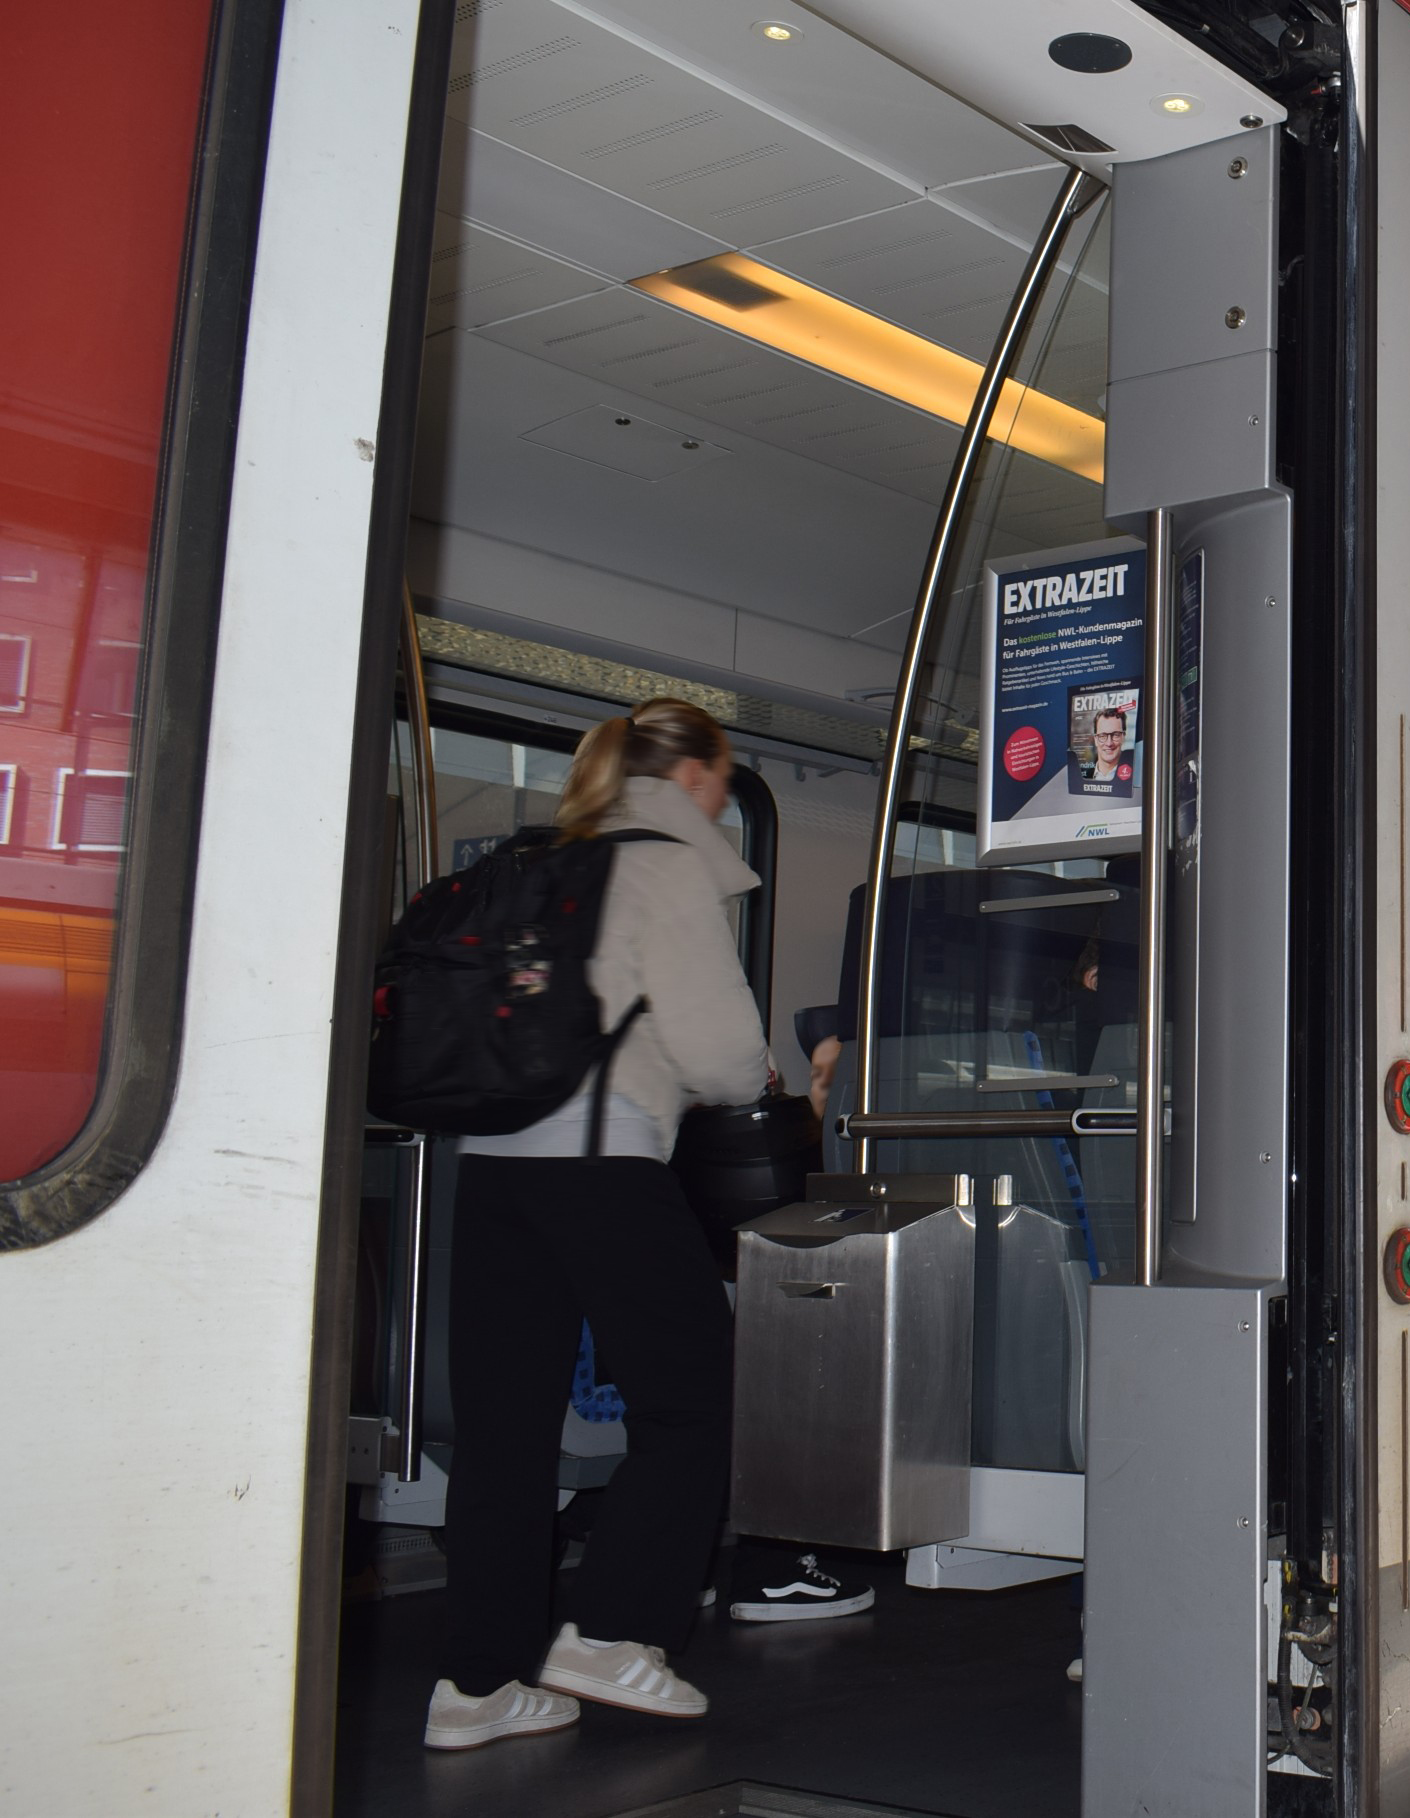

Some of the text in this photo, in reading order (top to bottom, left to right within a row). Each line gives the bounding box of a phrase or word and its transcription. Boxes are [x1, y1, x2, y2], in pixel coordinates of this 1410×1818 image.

[1004, 564, 1128, 614] EXTRAZEIT
[1015, 614, 1041, 624] Fahrgäste
[1048, 606, 1093, 617] Westfalen-Lippe
[1003, 618, 1143, 647] Das kostenlose NWL-Kundenmagazin
[1003, 635, 1123, 660] für Fahrgäste in Westfalen-Lippe
[1074, 692, 1134, 712] EXTRAZEIT
[1080, 761, 1096, 769] ndrik
[1083, 784, 1113, 792] EXTRAZEIT
[1088, 828, 1110, 837] NWL
